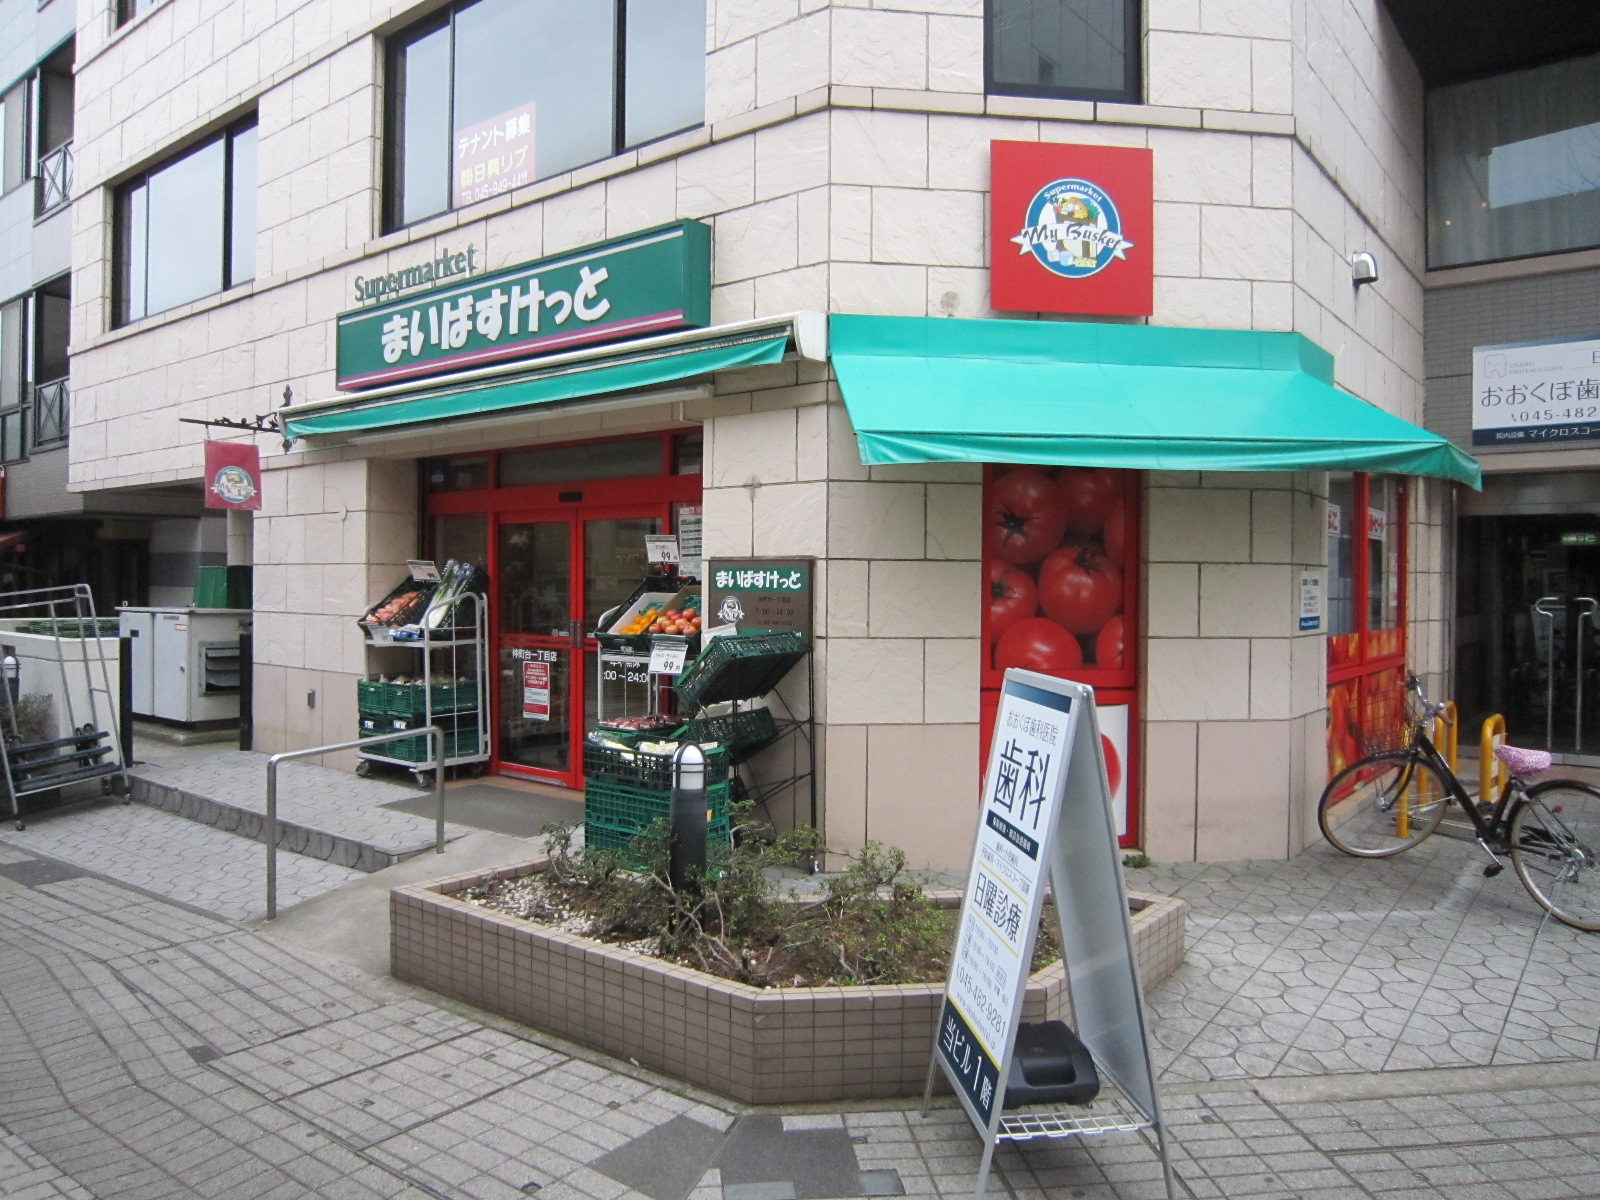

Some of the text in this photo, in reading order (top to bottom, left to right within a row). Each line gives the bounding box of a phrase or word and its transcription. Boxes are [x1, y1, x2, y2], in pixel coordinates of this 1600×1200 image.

[458, 112, 530, 159] テナント募集
[1044, 184, 1102, 203] Supermarket
[1023, 223, 1121, 249] My Basket
[354, 243, 477, 302] Supermarket
[381, 266, 611, 364] まいばすけっと
[1481, 378, 1600, 407] おおくぼ歯
[715, 570, 801, 589] まいばすけっと
[512, 648, 558, 662] 仲町台一丁目店
[1006, 709, 1059, 746] おおくぼ歯科医院
[993, 738, 1051, 831] 歯科
[973, 872, 1022, 944] 日曜診療
[959, 966, 1006, 1038] 045-482-9281
